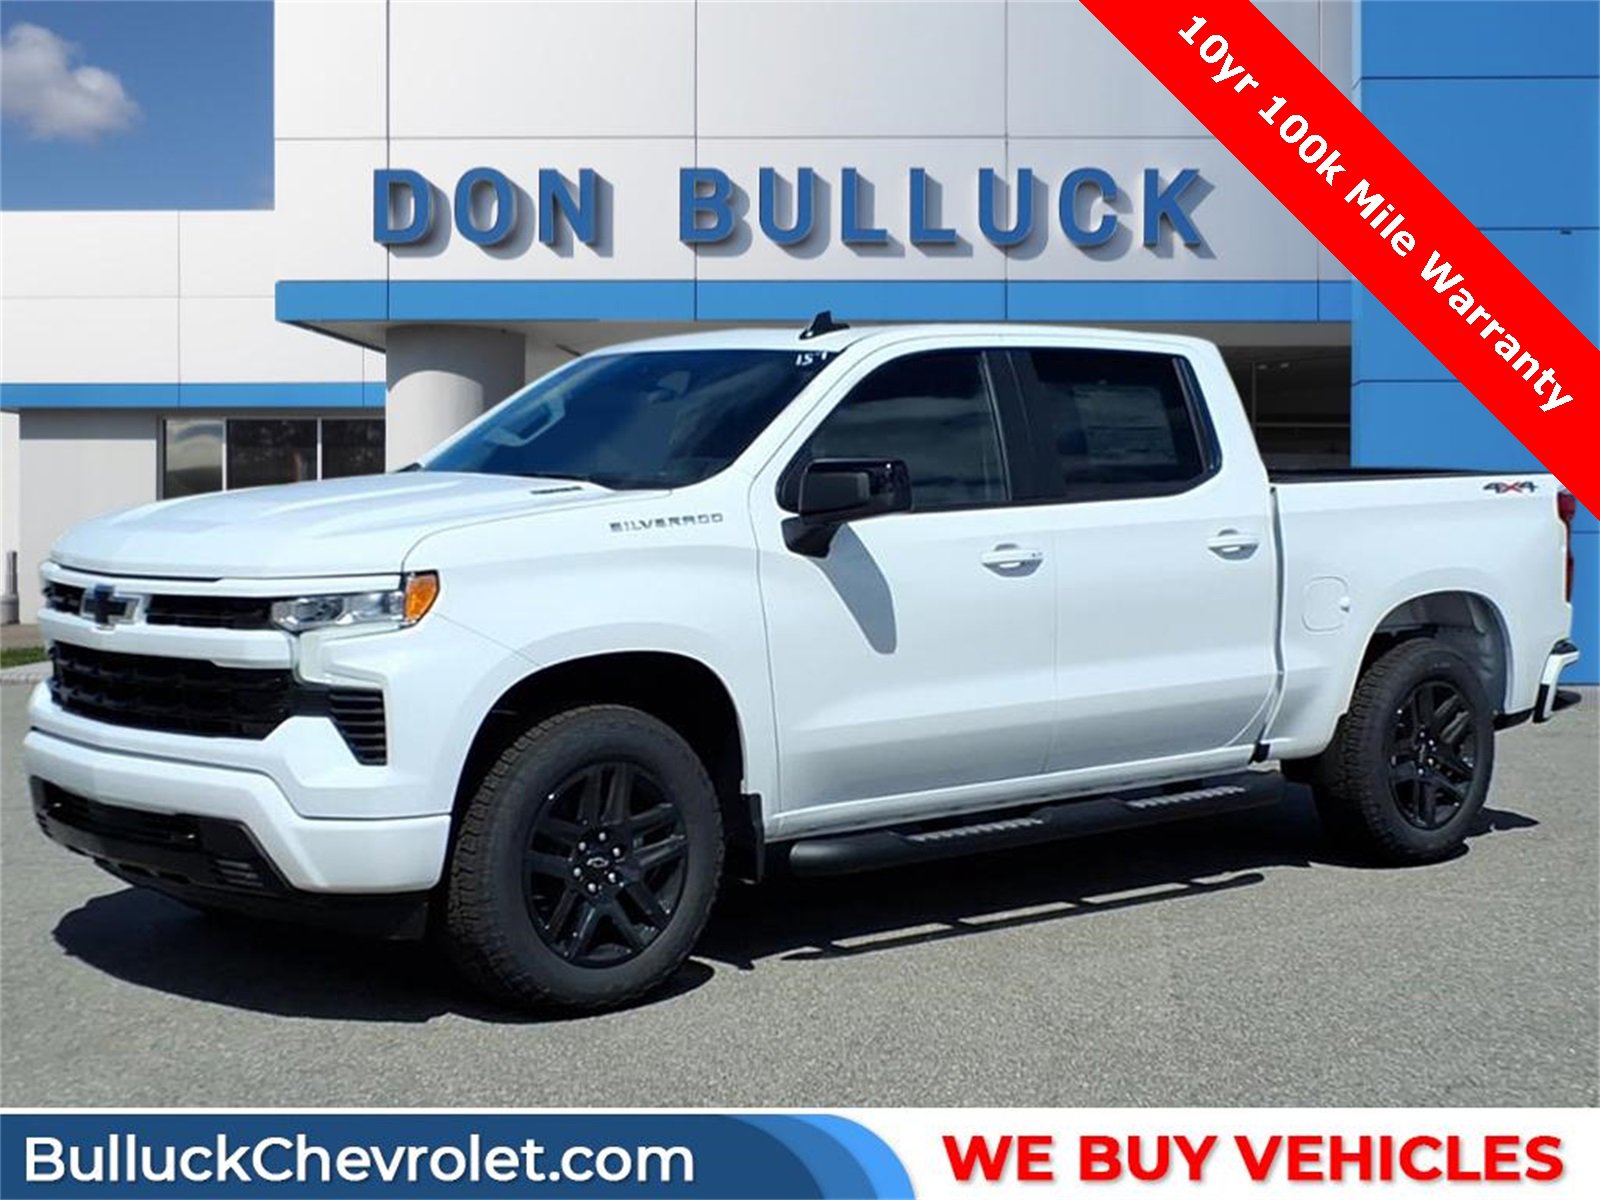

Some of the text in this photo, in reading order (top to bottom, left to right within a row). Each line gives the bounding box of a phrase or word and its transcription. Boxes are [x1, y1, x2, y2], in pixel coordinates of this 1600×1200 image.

[373, 167, 1203, 248] DON BULLUCK
[609, 512, 724, 533] SILVERADO
